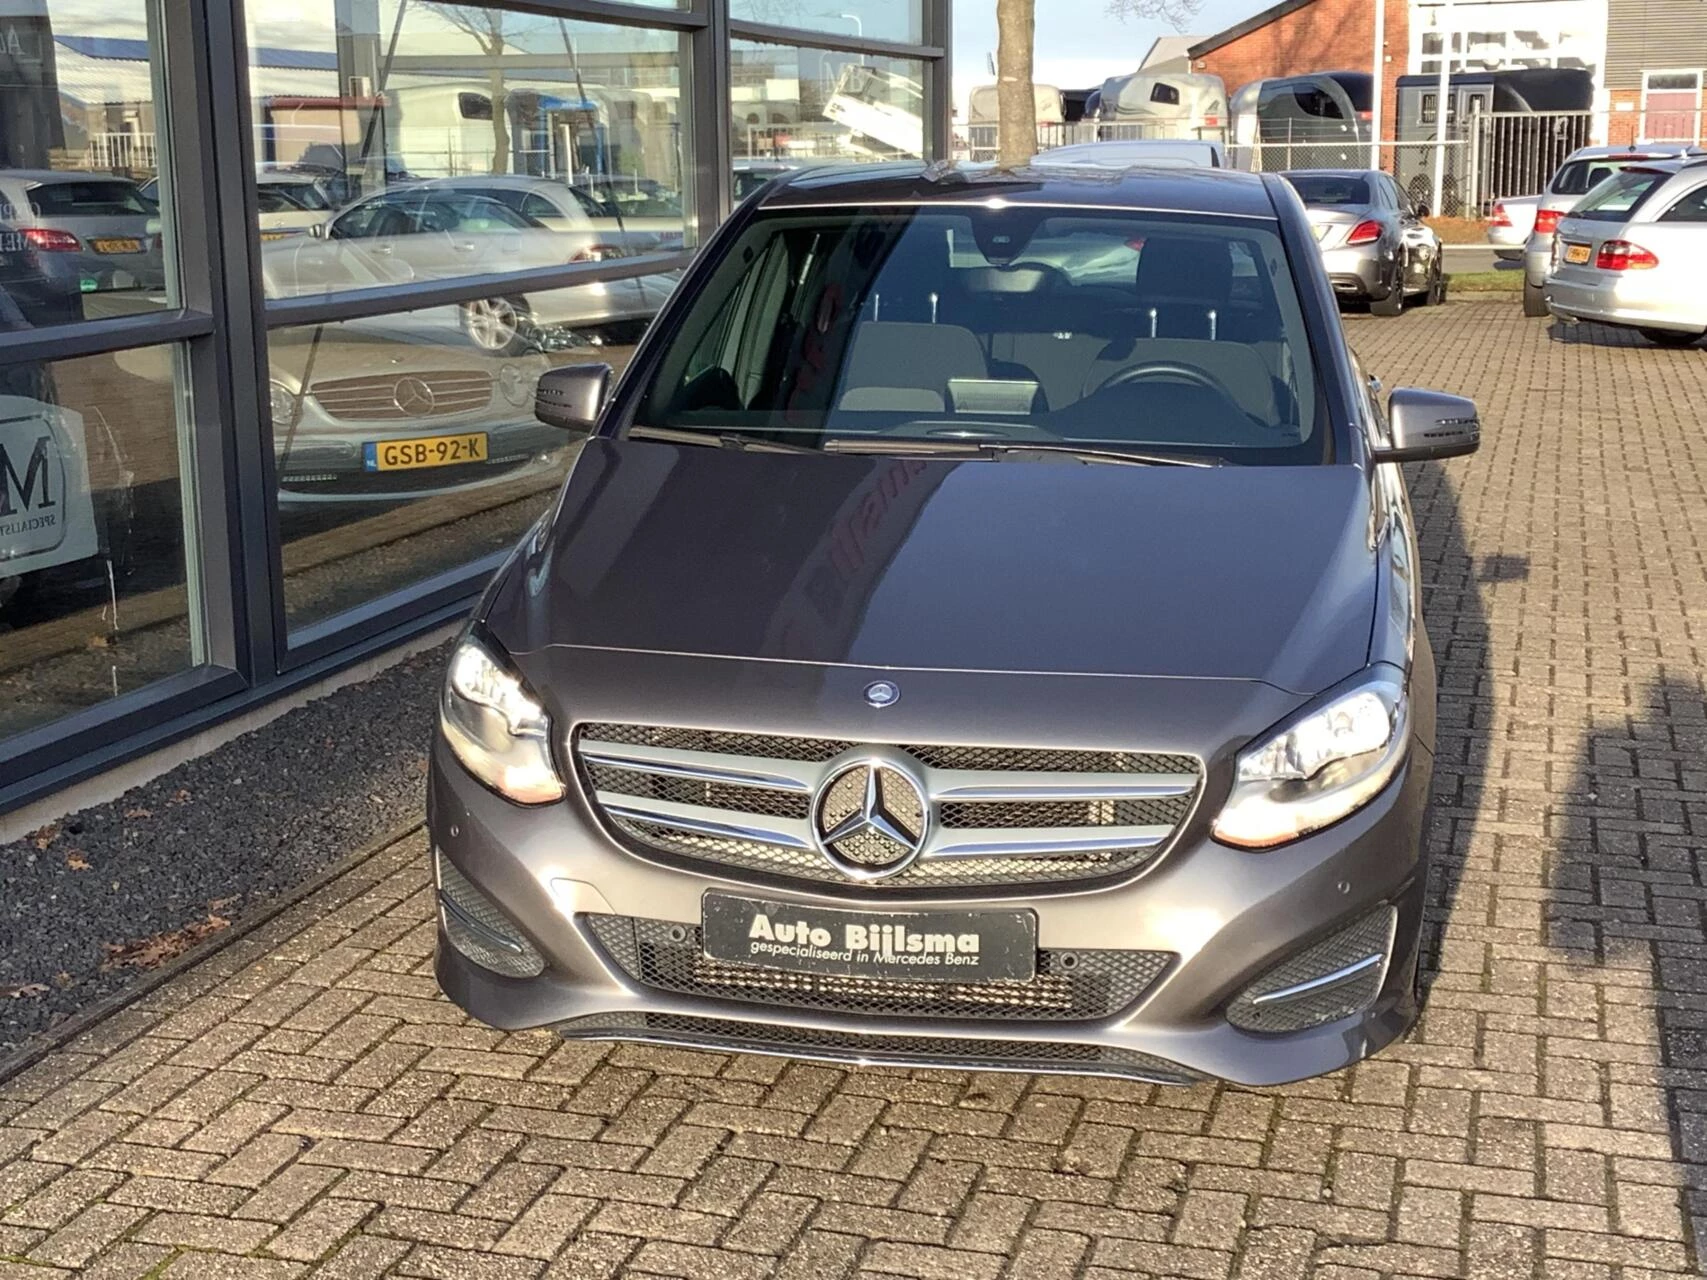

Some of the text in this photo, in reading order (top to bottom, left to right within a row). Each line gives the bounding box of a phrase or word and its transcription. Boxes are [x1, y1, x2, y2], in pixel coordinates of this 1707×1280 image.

[384, 437, 481, 466] GSB-92-K
[749, 913, 980, 958] Auto Bijlsma
[750, 941, 980, 966] gespecialiseerd in Mercedes Benz
